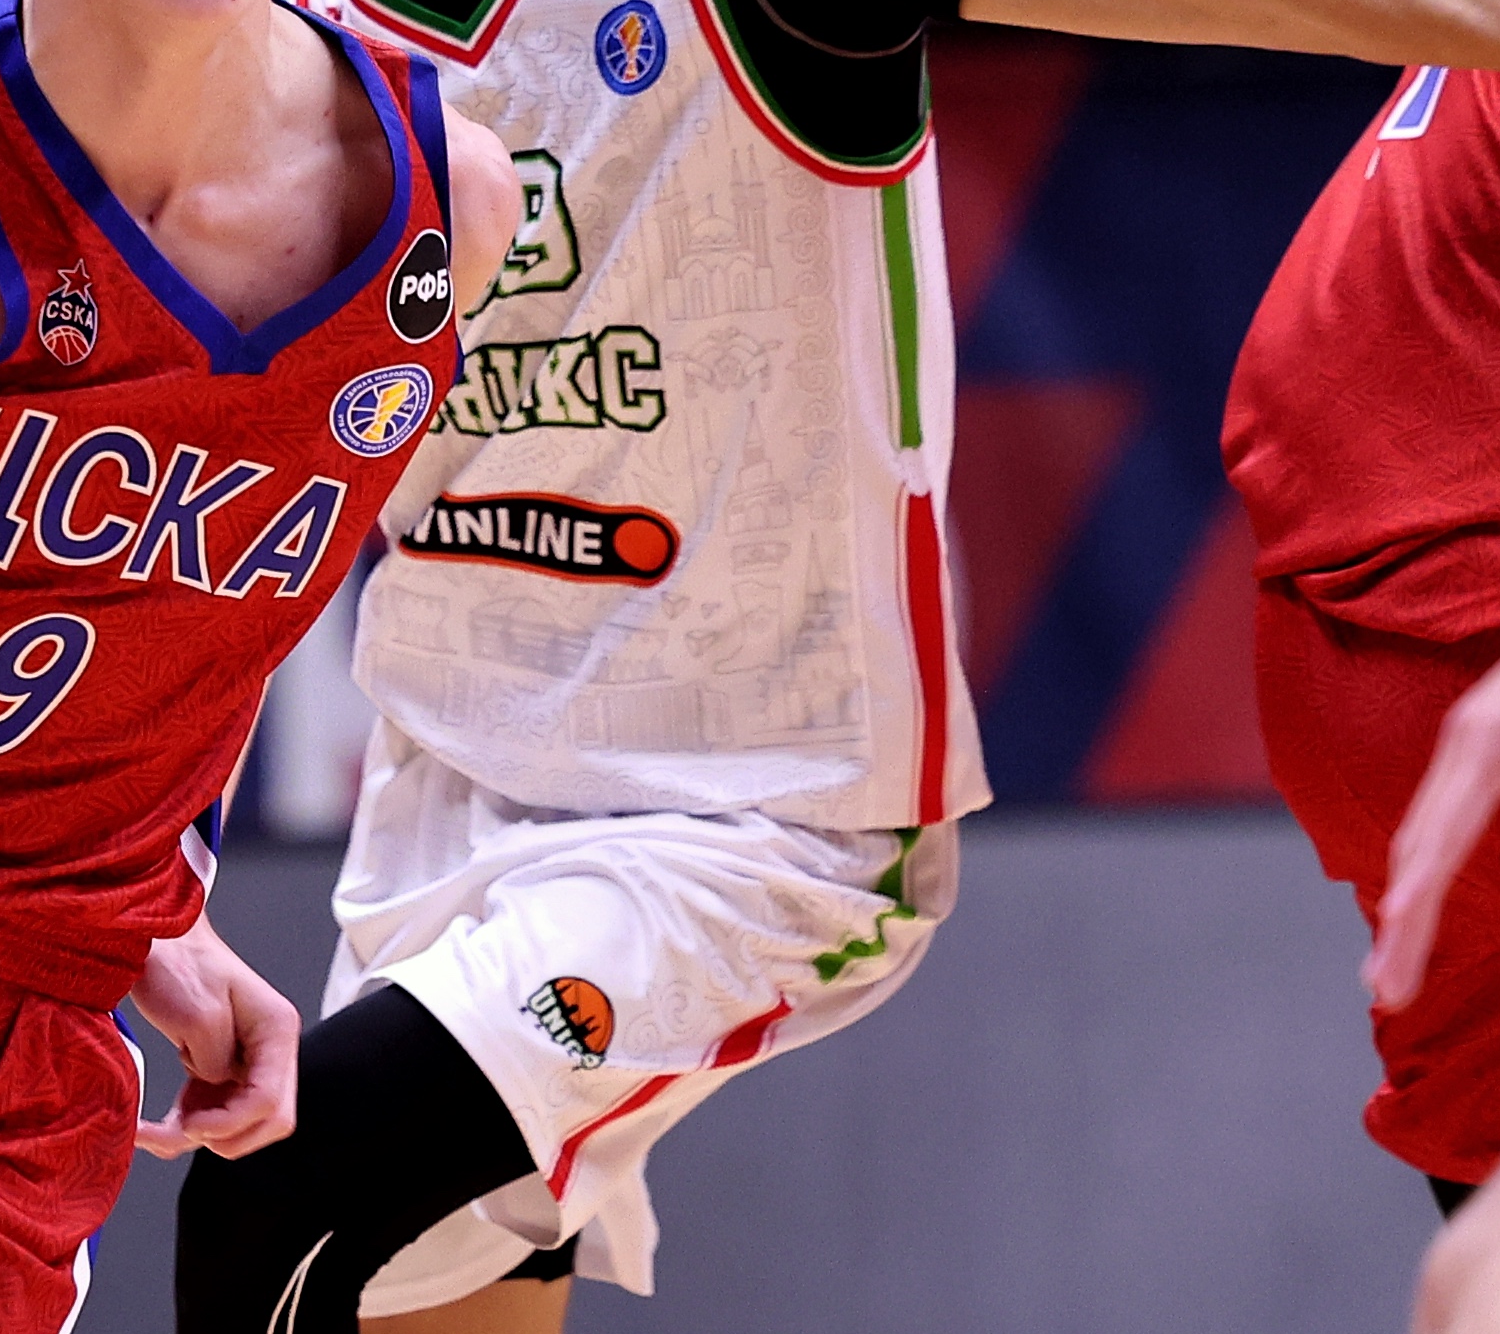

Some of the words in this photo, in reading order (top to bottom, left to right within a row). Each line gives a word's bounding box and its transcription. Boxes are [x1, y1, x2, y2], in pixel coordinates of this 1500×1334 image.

[398, 268, 449, 305] РФБ
[46, 300, 93, 330] CSKA
[428, 325, 667, 437] НИКС
